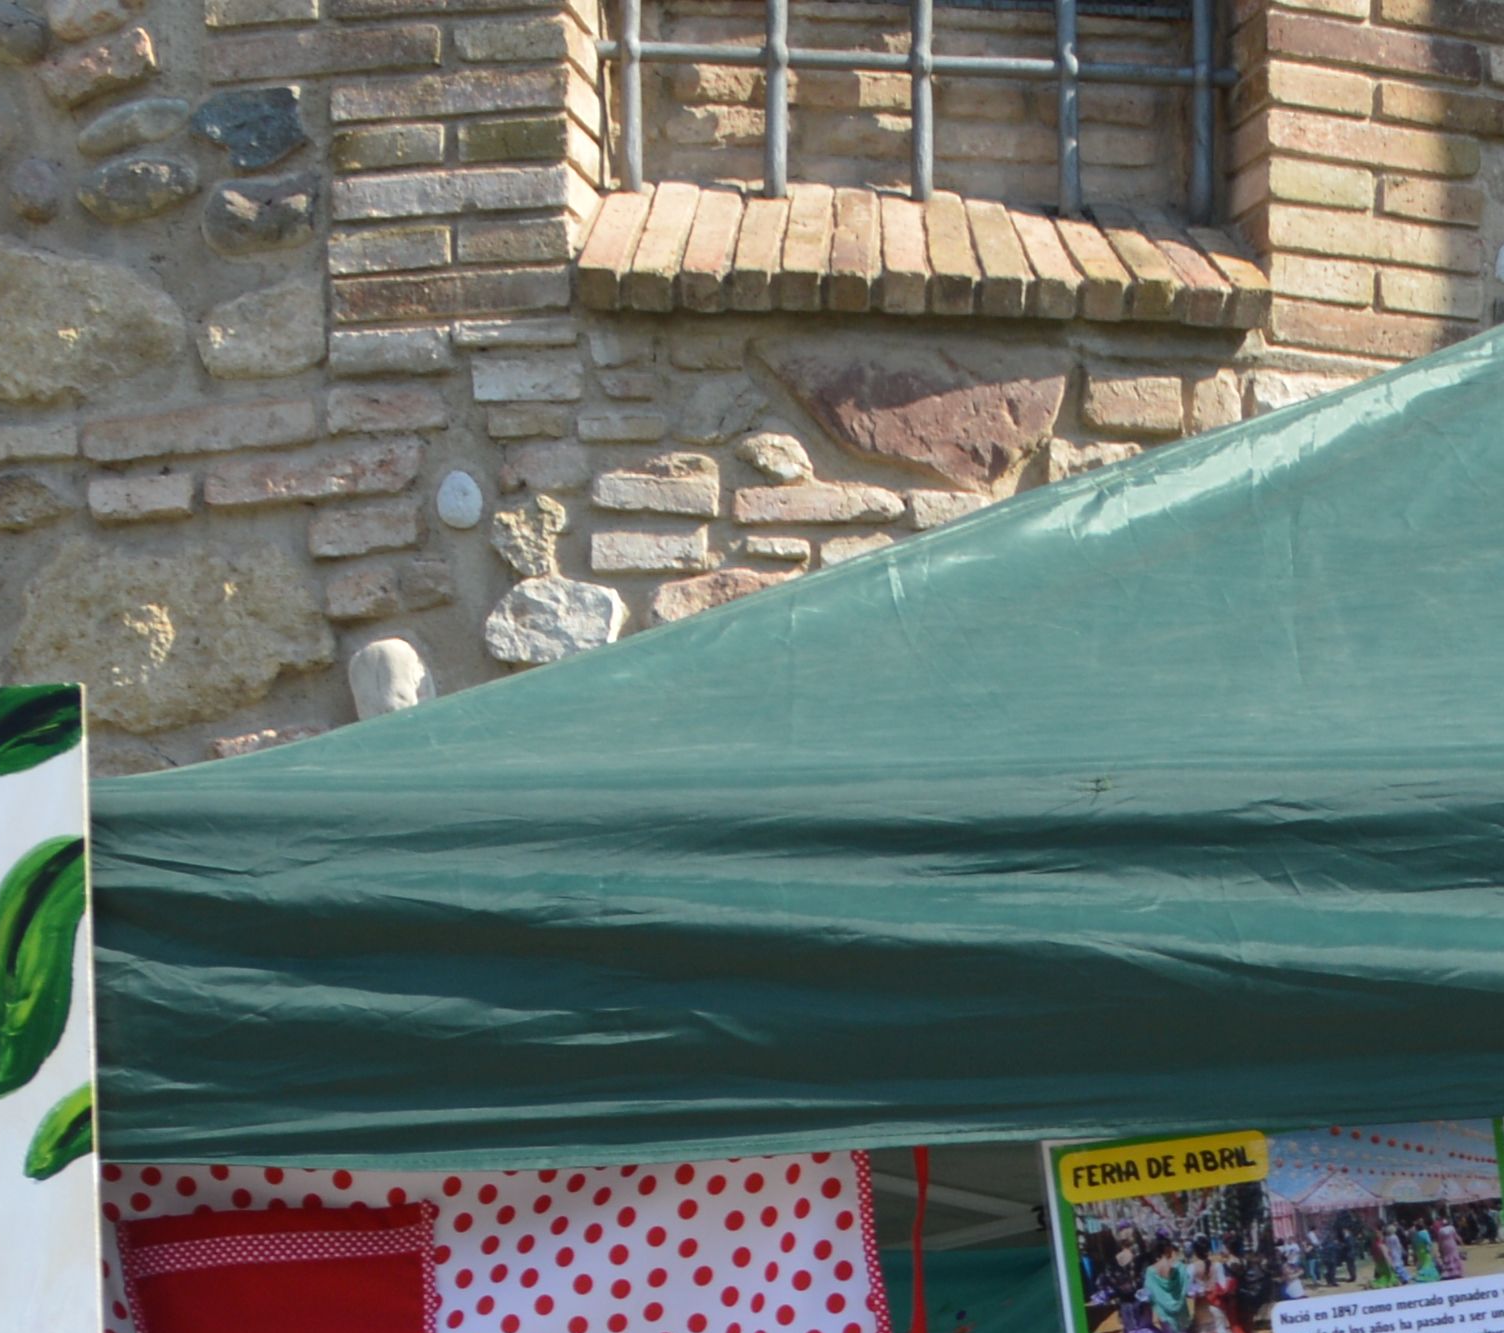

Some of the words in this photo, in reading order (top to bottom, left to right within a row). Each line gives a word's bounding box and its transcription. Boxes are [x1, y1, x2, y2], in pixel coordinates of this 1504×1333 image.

[1073, 1159, 1140, 1188] FERIA
[1146, 1155, 1176, 1179] DE
[1184, 1146, 1256, 1174] ABRIL
[1280, 1310, 1311, 1325] Nació
[1314, 1310, 1328, 1321] en
[1332, 1304, 1359, 1318] 1847
[1362, 1302, 1393, 1315] como
[1396, 1294, 1444, 1311] mercado
[1448, 1288, 1499, 1307] ganadero
[1369, 1319, 1395, 1333] años
[1399, 1317, 1412, 1331] ha
[1417, 1312, 1455, 1330] pasado
[1458, 1313, 1465, 1323] a
[1470, 1309, 1486, 1321] ser
